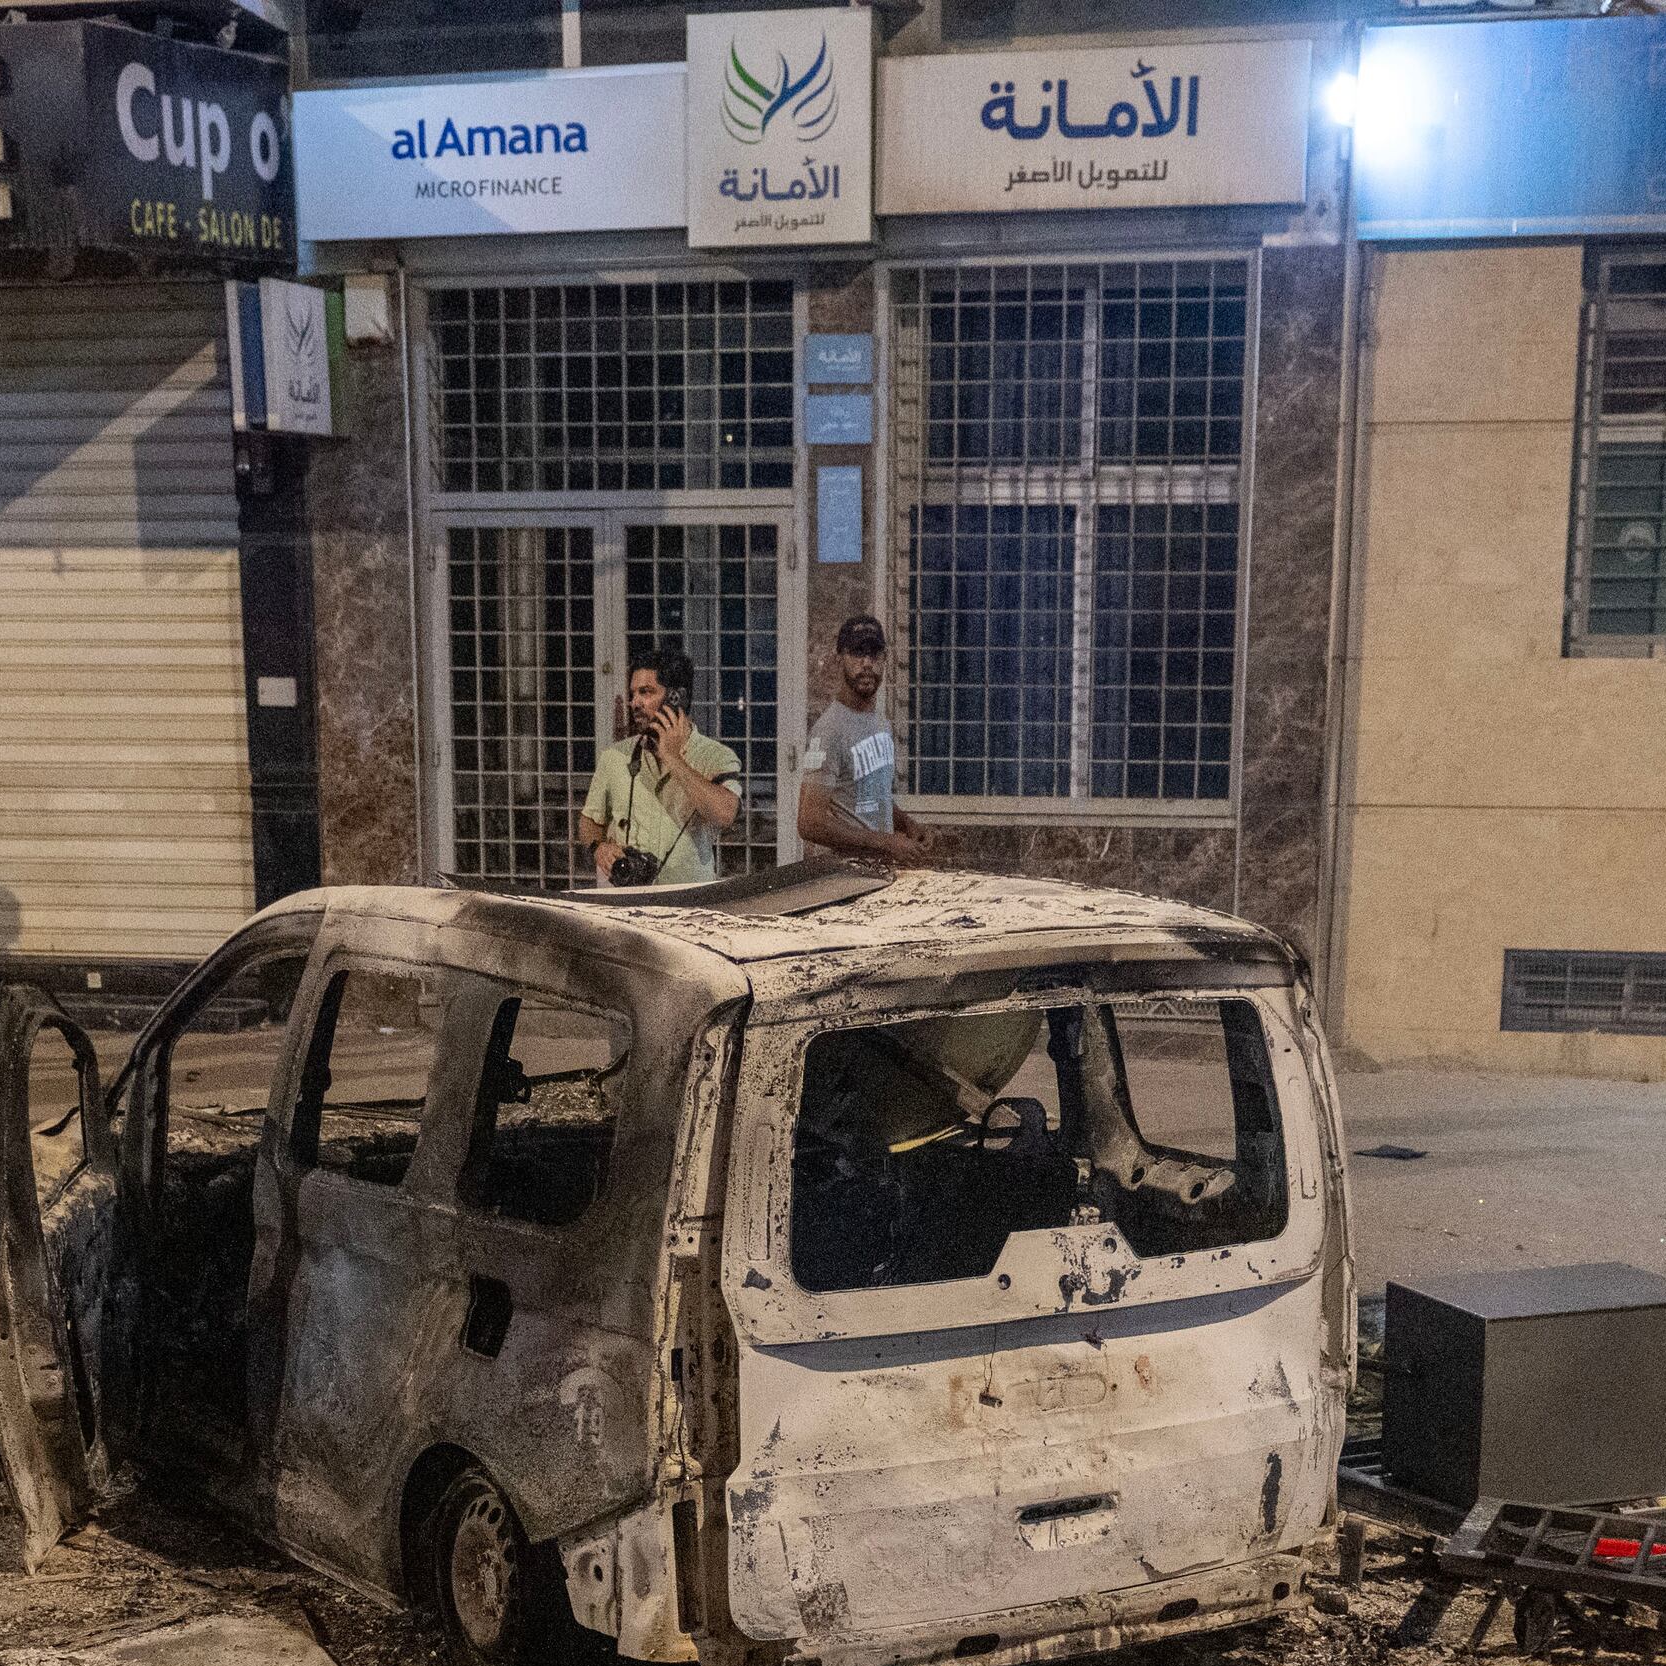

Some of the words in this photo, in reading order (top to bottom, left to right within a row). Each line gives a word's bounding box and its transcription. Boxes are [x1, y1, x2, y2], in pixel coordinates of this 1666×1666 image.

[979, 58, 1201, 141] الأمانة
[116, 62, 230, 200] Cup
[392, 118, 429, 162] al
[434, 117, 588, 158] Amana
[414, 176, 563, 199] MICROFINANCE
[719, 154, 840, 201] الأمانة
[1004, 160, 1073, 191] الأصغر
[1077, 159, 1167, 186] للتمويل
[130, 199, 178, 241] CAFE
[199, 206, 255, 249] SALON
[261, 213, 283, 251] DE
